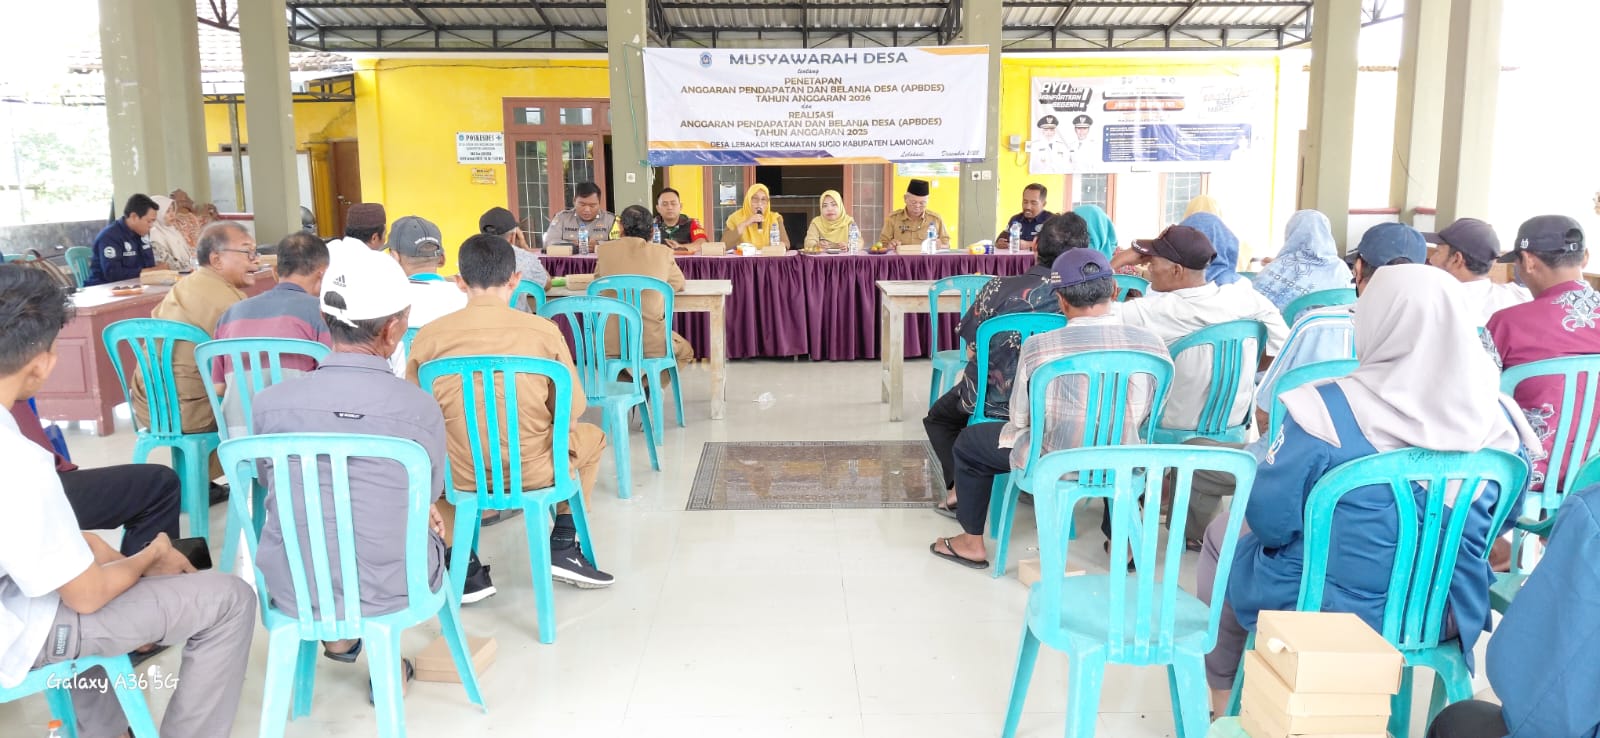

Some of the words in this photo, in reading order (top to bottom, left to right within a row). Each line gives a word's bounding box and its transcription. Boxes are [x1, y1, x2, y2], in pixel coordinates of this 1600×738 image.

[729, 53, 858, 65] MUSYAWARAH
[863, 52, 908, 64] DESA
[784, 77, 842, 85] PENETAPAN
[681, 86, 736, 94] ANGGARAN
[739, 86, 804, 94] PENDAPATAN
[830, 85, 871, 93] BELANJA
[874, 84, 898, 92] DESA
[900, 83, 945, 93] (APBDES)
[756, 95, 789, 103] TAHUN
[791, 94, 847, 103] ANGGARAN
[848, 94, 871, 102] 2026
[788, 111, 834, 119] REALISASI
[680, 120, 735, 128] ANGGARAN
[737, 120, 802, 128] PENDAPATAN
[828, 119, 869, 127] BELANJA
[872, 118, 896, 127] DESA
[898, 117, 942, 127] (APBDES)
[755, 129, 788, 137] TAHUN
[790, 128, 845, 136] ANGGARAN
[847, 128, 869, 136] 2025
[842, 139, 888, 147] KABUPATEN
[890, 138, 935, 146] LAMONGAN
